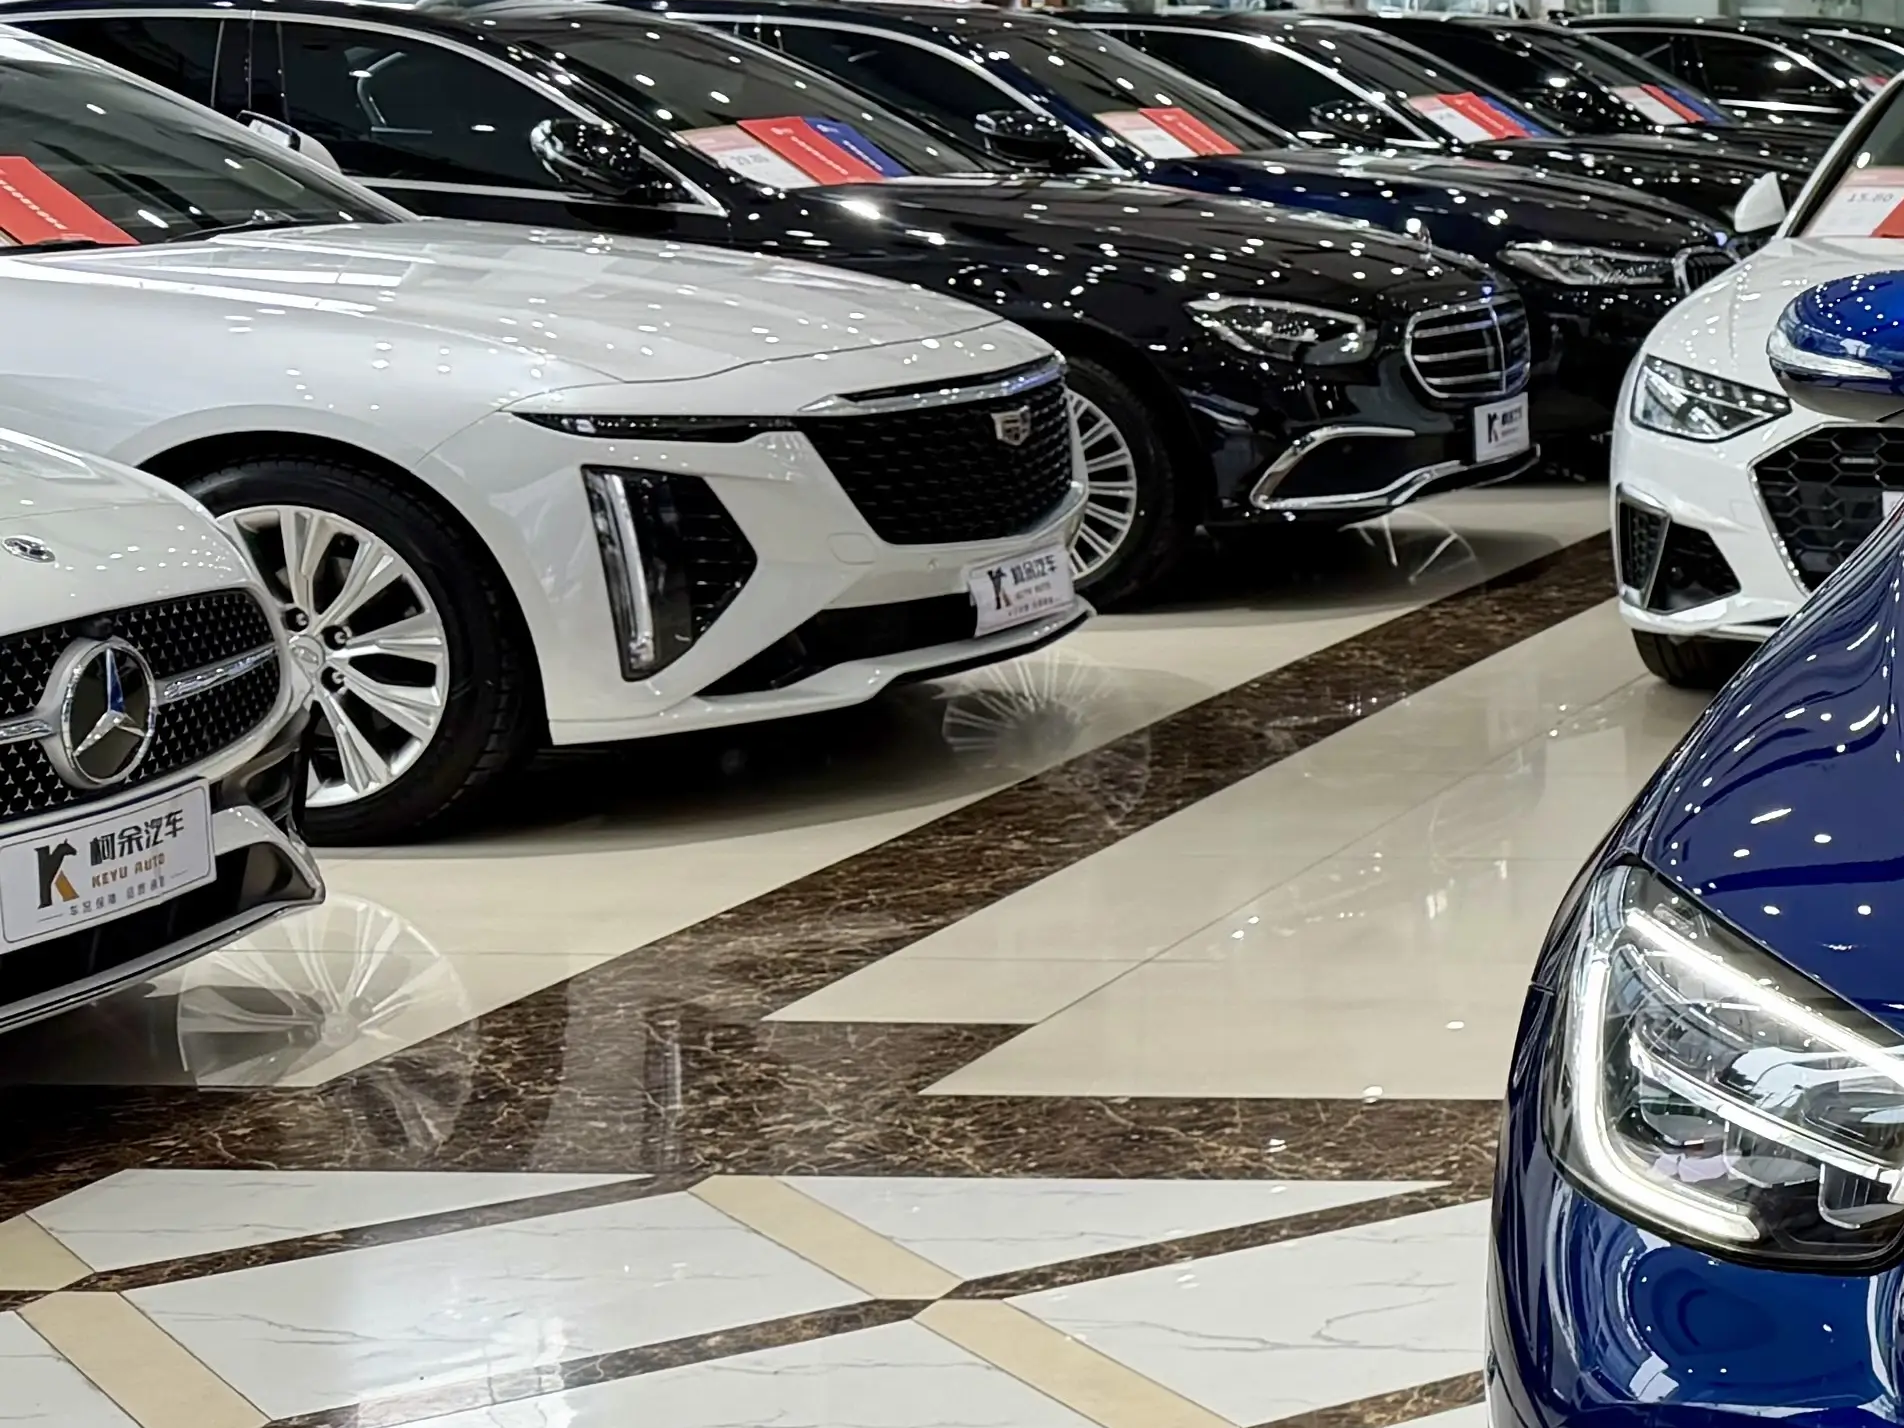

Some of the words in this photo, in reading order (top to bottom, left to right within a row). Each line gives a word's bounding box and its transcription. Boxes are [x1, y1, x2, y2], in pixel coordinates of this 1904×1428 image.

[89, 809, 185, 866] 柯余汽车
[91, 865, 129, 888] KEYU
[134, 853, 165, 874] AUTO
